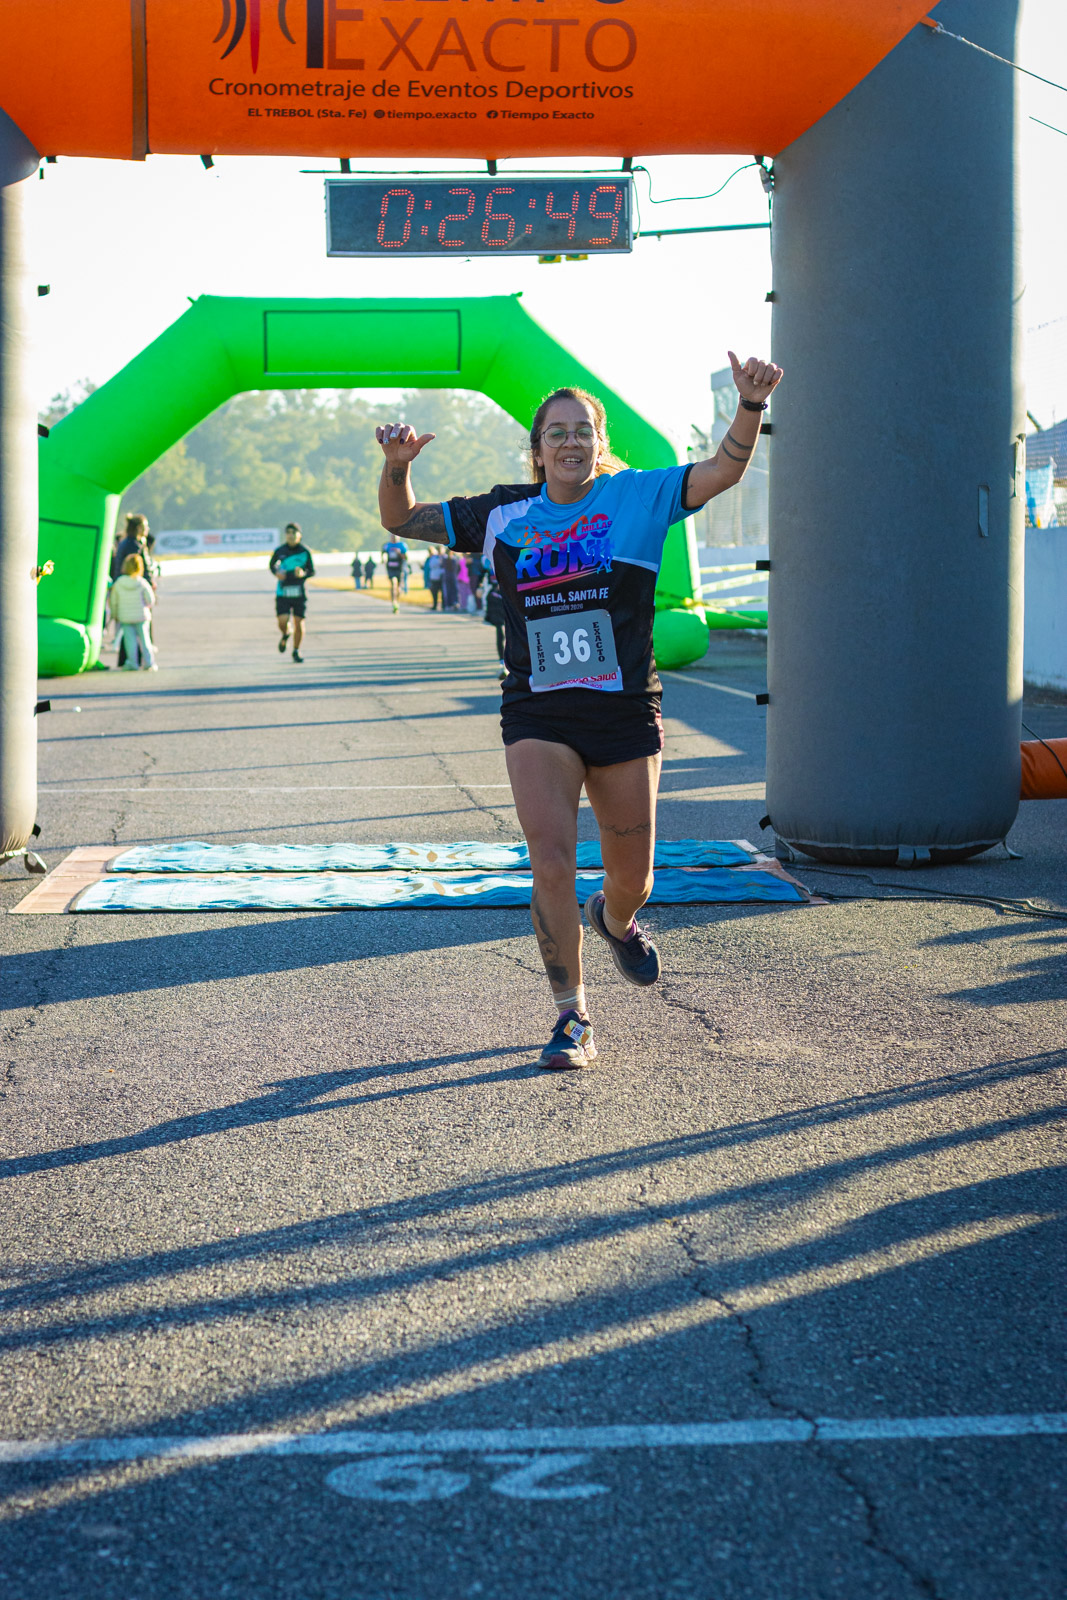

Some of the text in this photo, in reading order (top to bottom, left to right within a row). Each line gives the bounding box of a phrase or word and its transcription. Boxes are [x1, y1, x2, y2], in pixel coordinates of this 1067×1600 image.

[327, 0, 638, 73] EXACTO
[208, 78, 634, 102] Cronometraje de Eventos Deportivos
[248, 108, 595, 121] EL TREBOL (Sta. Fe) tiempo.exacto Tiempo Exacto
[377, 185, 623, 248] 0:26:49
[581, 520, 613, 534] MILLAS
[524, 587, 609, 608] RAFAELA, SANTA FE
[534, 631, 546, 672] TIEMPO
[552, 628, 591, 665] 36
[592, 621, 606, 662] EXACTO
